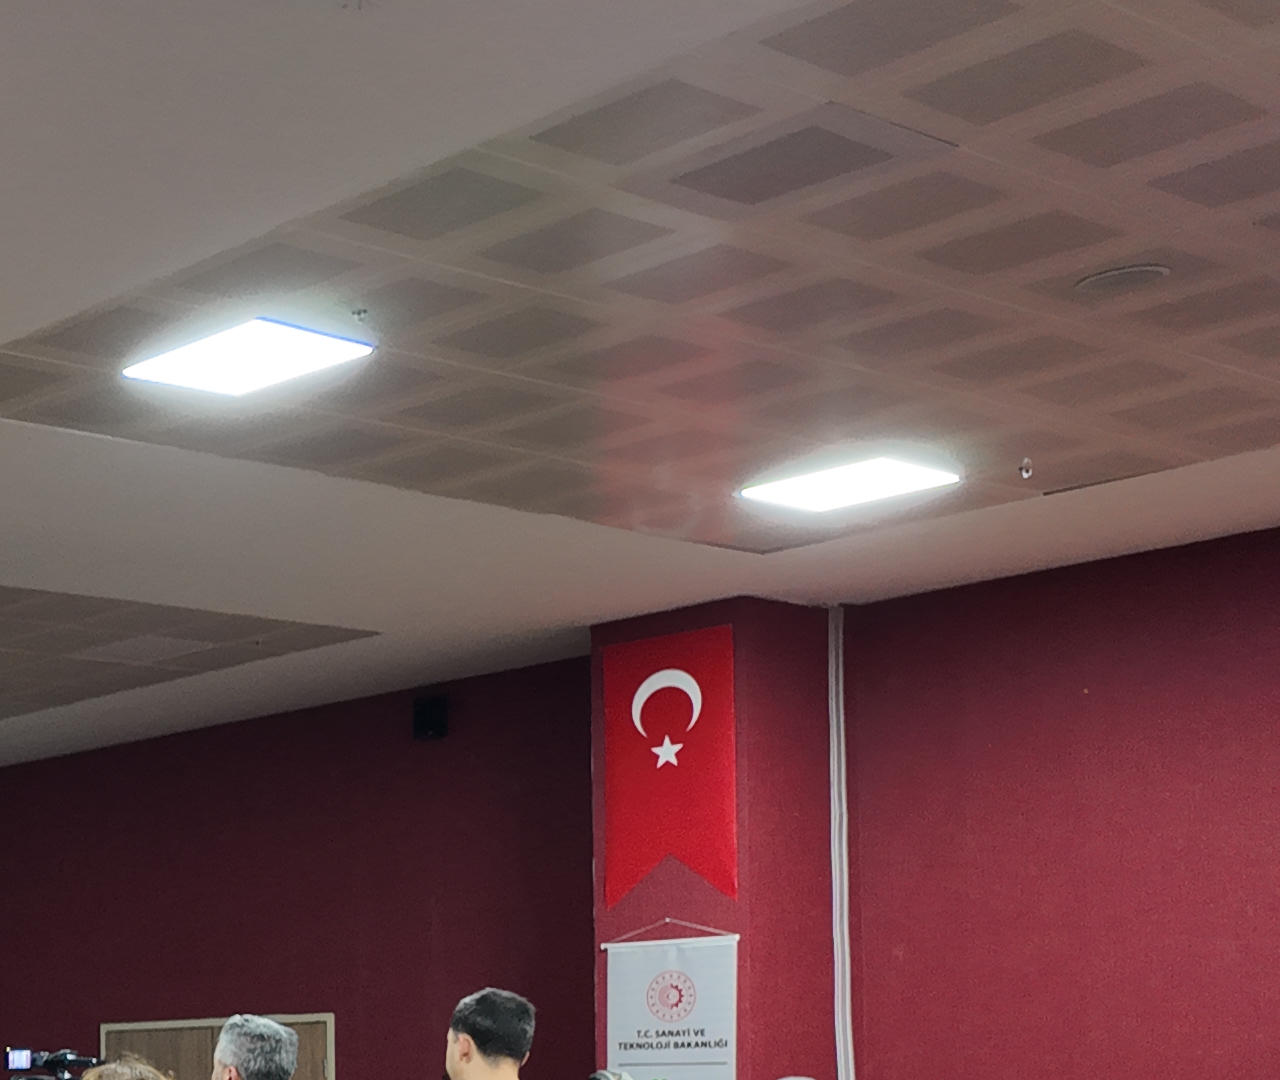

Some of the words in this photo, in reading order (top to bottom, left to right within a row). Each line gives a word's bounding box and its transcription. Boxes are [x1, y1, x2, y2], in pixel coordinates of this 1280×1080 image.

[655, 1028, 691, 1038] SANAYİ
[693, 1028, 706, 1037] VE
[618, 1040, 671, 1051] TEKNOLOJİ
[673, 1038, 728, 1050] BAKANLIĞI
